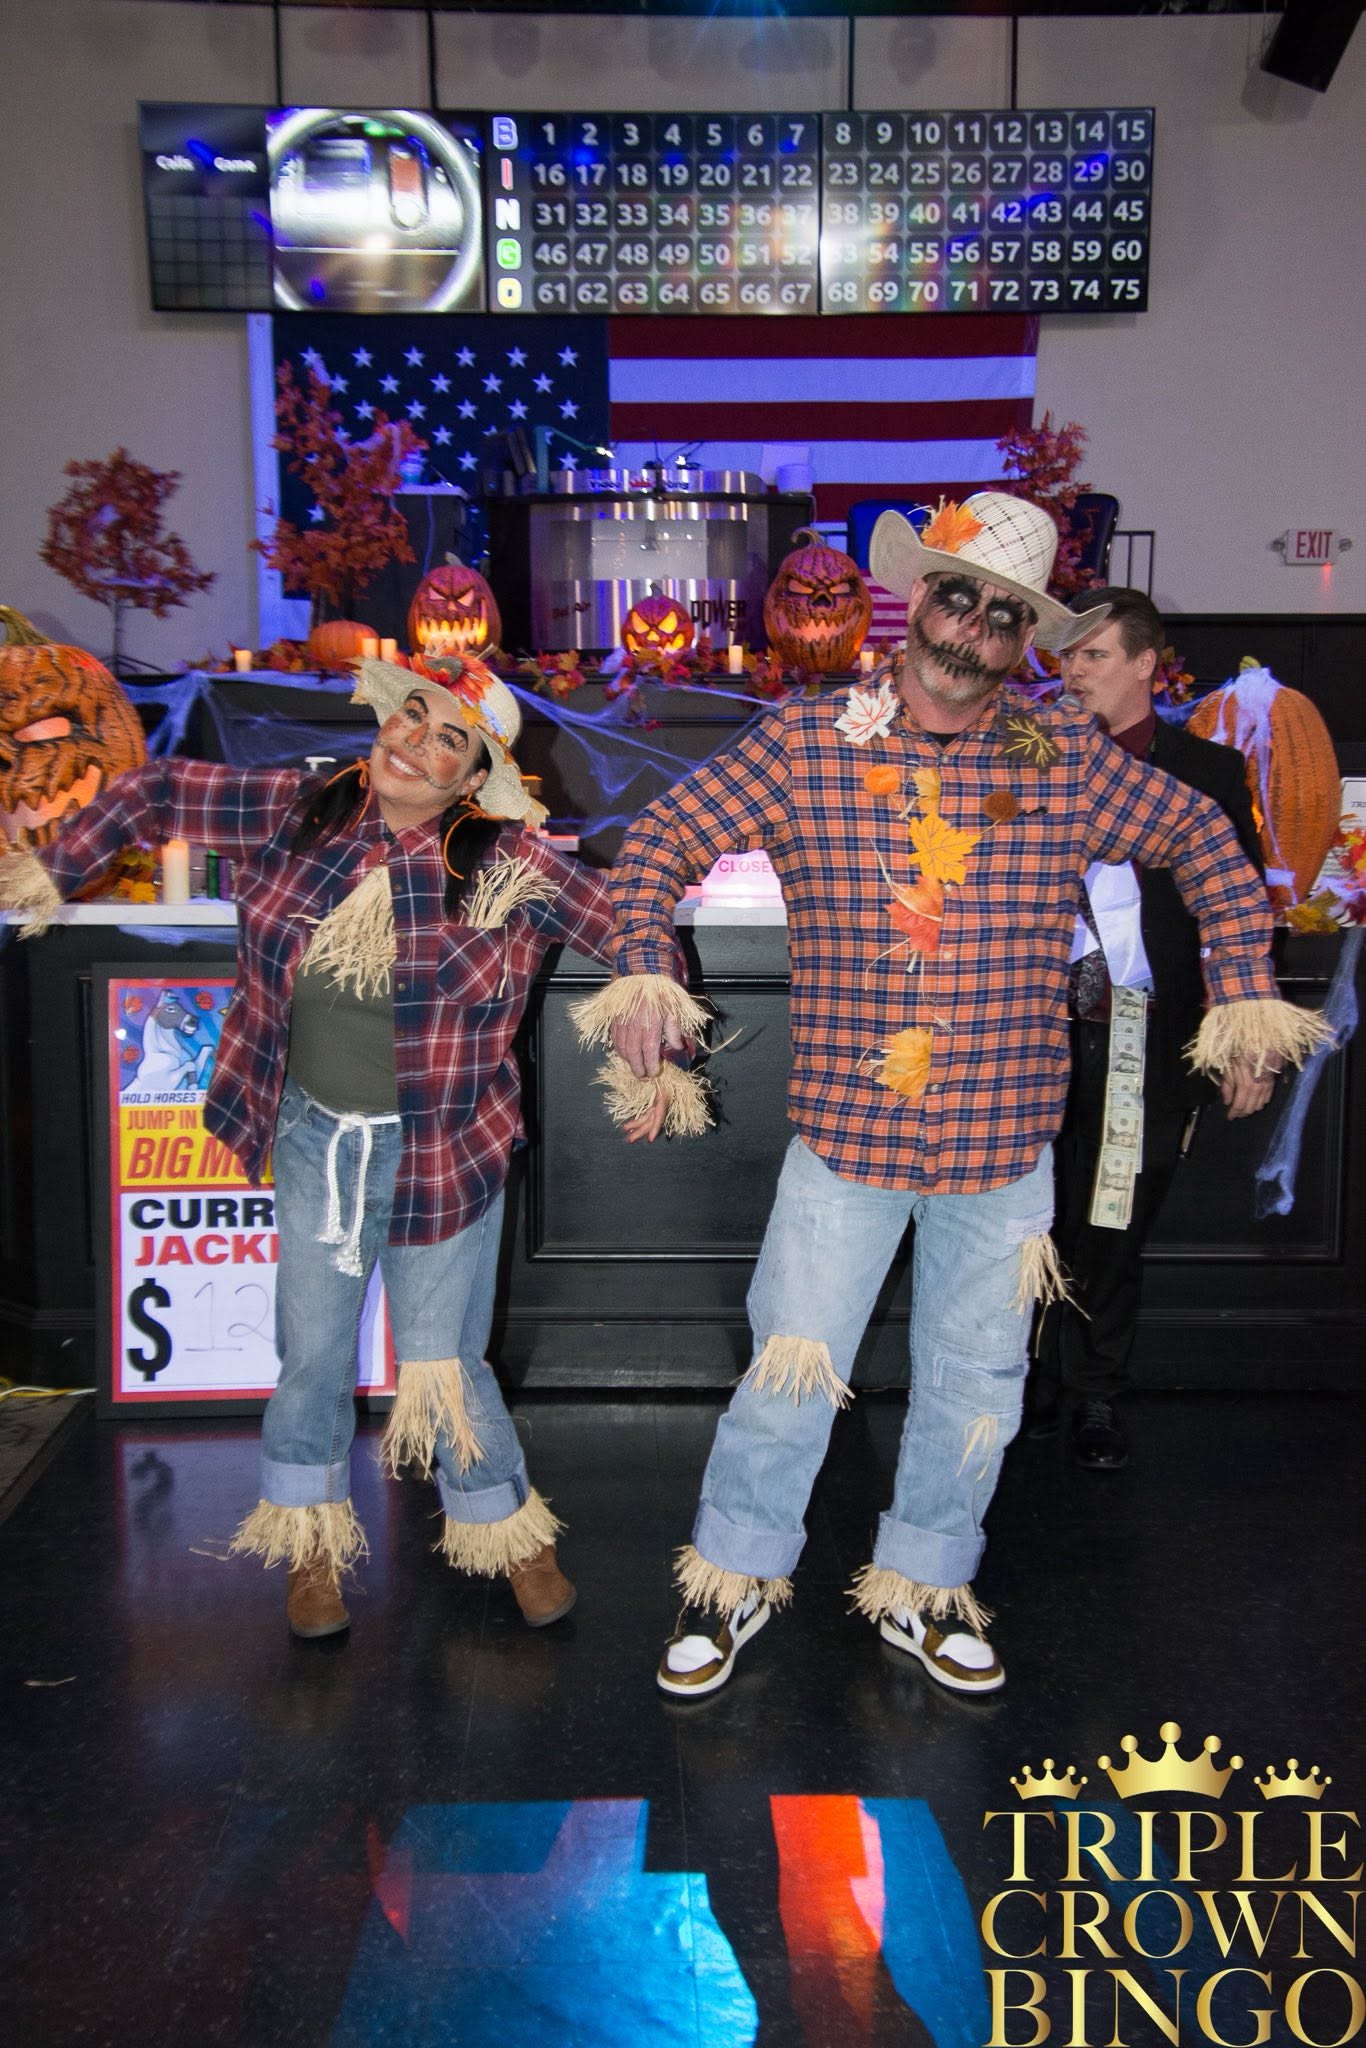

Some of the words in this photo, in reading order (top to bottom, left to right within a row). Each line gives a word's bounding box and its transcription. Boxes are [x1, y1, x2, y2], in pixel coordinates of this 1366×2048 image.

[492, 117, 518, 150] B
[543, 123, 555, 145] 1
[582, 123, 599, 145] 2
[623, 123, 639, 145] 3
[665, 123, 681, 146] 4
[707, 124, 722, 146] 5
[748, 124, 763, 146] 6
[788, 124, 804, 146] 7
[835, 123, 851, 145] 8
[877, 123, 893, 144] 9
[912, 123, 941, 143] 10
[954, 122, 981, 143] 11
[993, 122, 1022, 143] 12
[1035, 121, 1063, 142] 13
[1076, 121, 1104, 142] 14
[1117, 120, 1145, 141] 15
[501, 158, 513, 190] I
[535, 165, 565, 185] 16
[576, 165, 606, 185] 17
[617, 165, 648, 185] 18
[659, 164, 689, 185] 19
[699, 165, 730, 185] 20
[743, 165, 770, 185] 21
[782, 165, 813, 185] 22
[829, 163, 858, 185] 23
[869, 163, 899, 184] 24
[911, 163, 940, 184] 25
[951, 162, 981, 183] 26
[992, 162, 1022, 183] 27
[1033, 162, 1063, 183] 28
[1074, 161, 1103, 182] 29
[1115, 161, 1145, 181] 30
[496, 199, 520, 230] N
[536, 205, 566, 225] 31
[576, 205, 607, 225] 32
[617, 204, 648, 225] 33
[658, 204, 689, 225] 34
[700, 204, 730, 225] 35
[741, 204, 771, 225] 36
[782, 204, 811, 224] 37
[829, 203, 858, 224] 38
[869, 203, 899, 224] 39
[910, 202, 940, 224] 40
[952, 202, 980, 223] 41
[992, 202, 1022, 223] 42
[1032, 202, 1062, 222] 43
[1072, 201, 1103, 222] 44
[1114, 201, 1144, 222] 45
[497, 238, 522, 269] G
[535, 244, 567, 265] 46
[576, 244, 607, 265] 47
[617, 244, 648, 265] 48
[658, 244, 690, 265] 49
[699, 244, 730, 265] 50
[742, 245, 770, 265] 51
[782, 245, 812, 265] 52
[869, 243, 899, 264] 54
[910, 243, 939, 263] 55
[950, 242, 980, 263] 56
[990, 242, 1021, 263] 57
[1031, 241, 1061, 262] 58
[1071, 241, 1101, 262] 59
[1111, 241, 1142, 261] 60
[498, 277, 522, 308] O
[538, 283, 566, 304] 61
[577, 283, 607, 304] 62
[618, 283, 649, 304] 63
[659, 283, 689, 304] 64
[700, 284, 730, 304] 65
[741, 284, 770, 304] 66
[781, 284, 812, 304] 67
[827, 282, 858, 303] 68
[868, 282, 898, 303] 69
[909, 282, 939, 303] 70
[951, 281, 978, 302] 71
[991, 281, 1020, 302] 72
[1031, 281, 1059, 301] 73
[1070, 280, 1100, 301] 74
[1111, 280, 1140, 300] 75
[1296, 531, 1333, 558] EXIT
[718, 860, 775, 873] CLOSE
[121, 1093, 151, 1104] HOLD
[153, 1092, 197, 1104] HORSES
[127, 1110, 175, 1130] JUMP
[179, 1109, 197, 1130] IN
[127, 1136, 194, 1179] BIG
[129, 1198, 275, 1230] CURR
[126, 1278, 172, 1382] $
